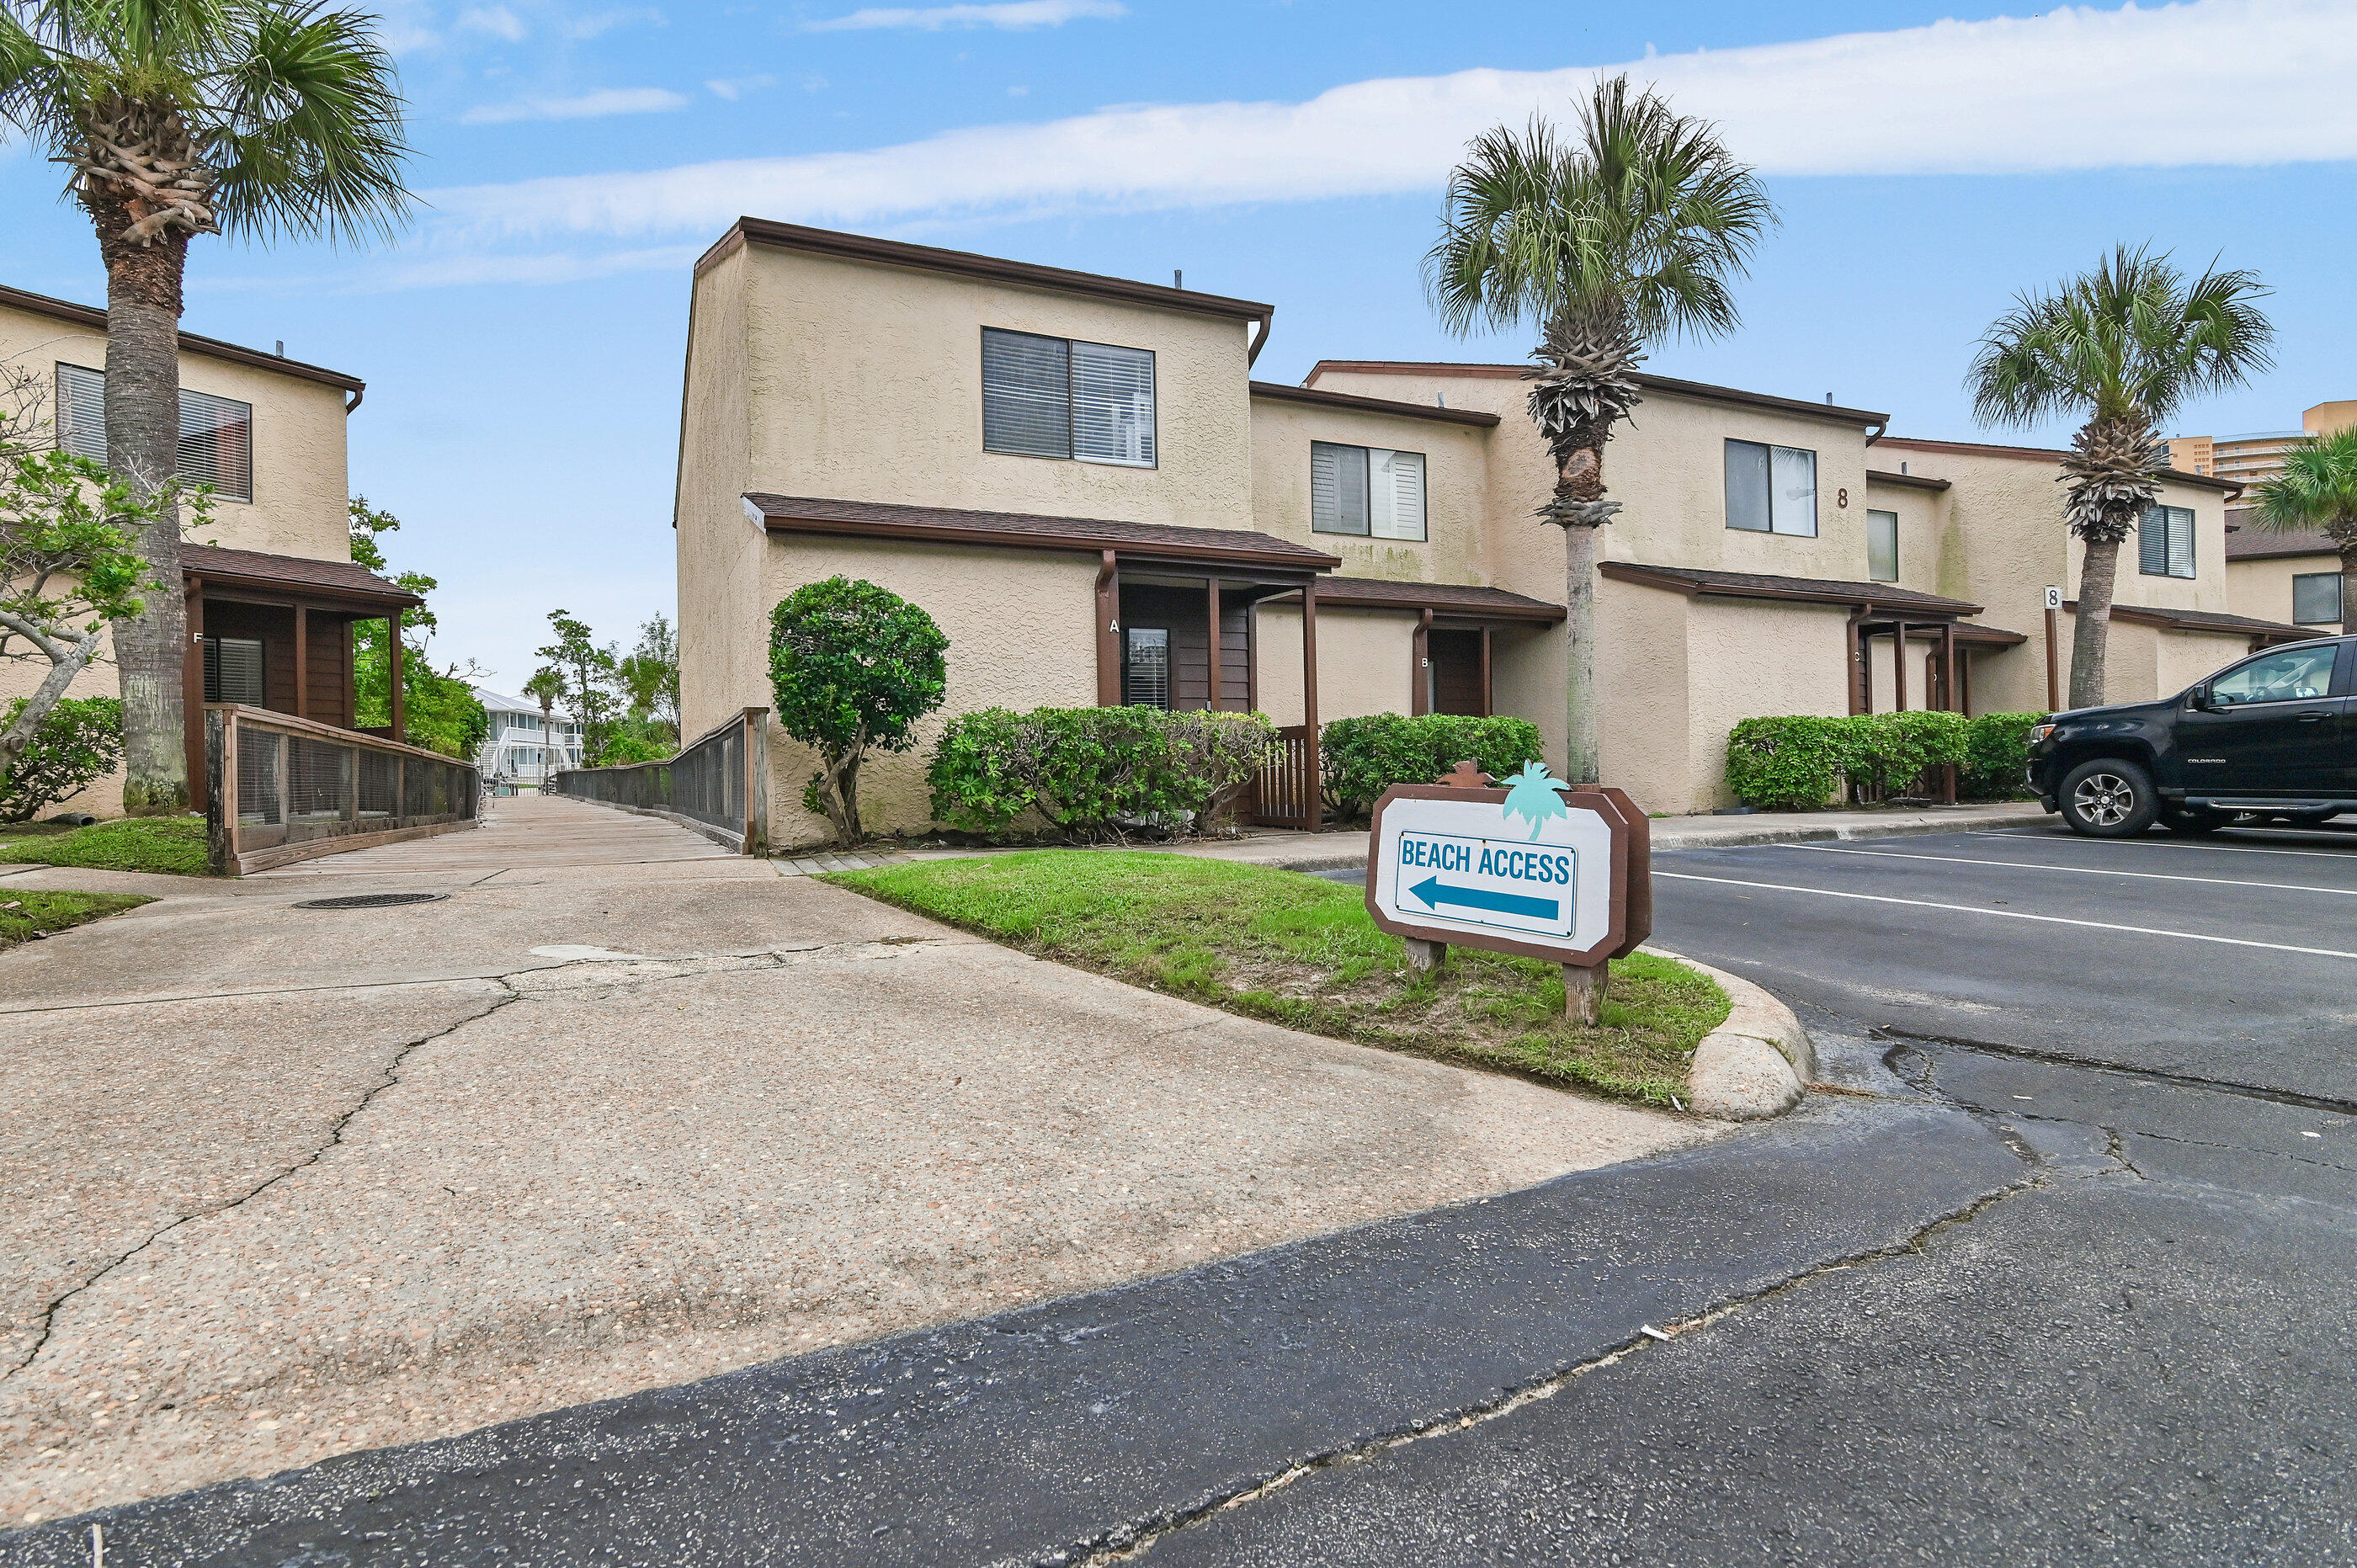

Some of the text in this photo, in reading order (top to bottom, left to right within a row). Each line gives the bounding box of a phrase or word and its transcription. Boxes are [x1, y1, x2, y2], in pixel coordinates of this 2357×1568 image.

[1838, 488, 1848, 508] 8
[2049, 590, 2057, 605] 8
[1109, 619, 1120, 633] A
[193, 632, 203, 643] F
[1422, 658, 1429, 667] B
[1402, 839, 1570, 885] BEACH ACCESS
